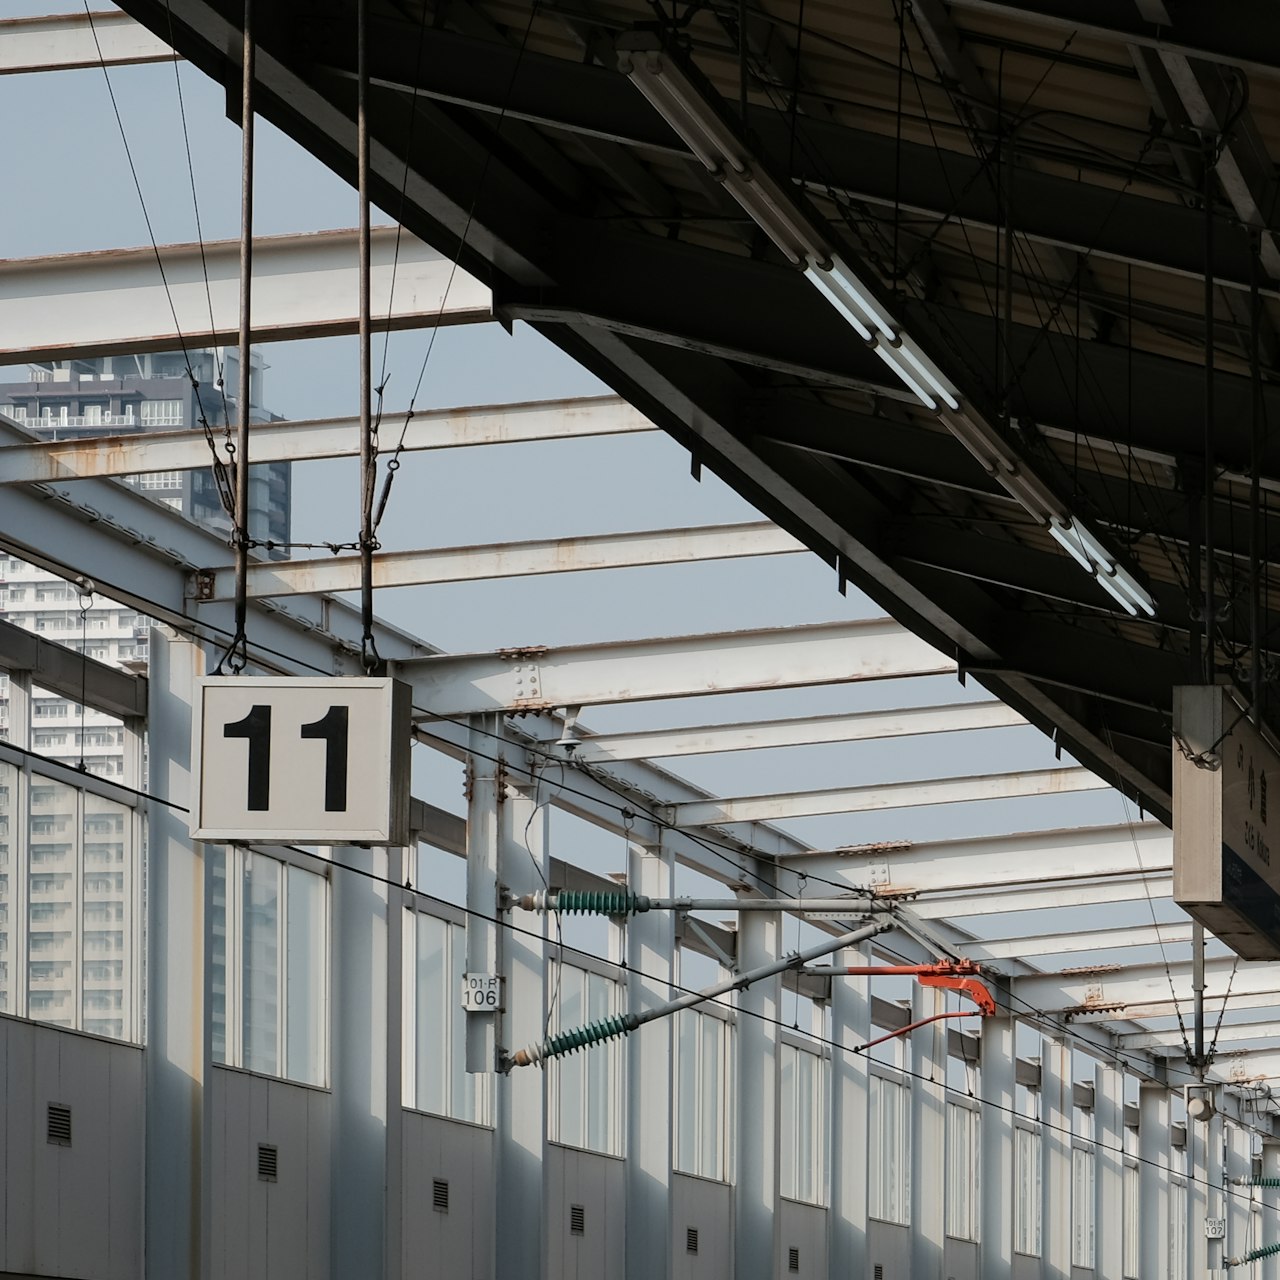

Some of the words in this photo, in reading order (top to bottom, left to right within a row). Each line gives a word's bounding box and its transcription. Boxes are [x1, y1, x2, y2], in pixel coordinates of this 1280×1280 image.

[223, 705, 350, 812] 11
[464, 990, 496, 1006] 106
[1206, 1227, 1223, 1235] 107
